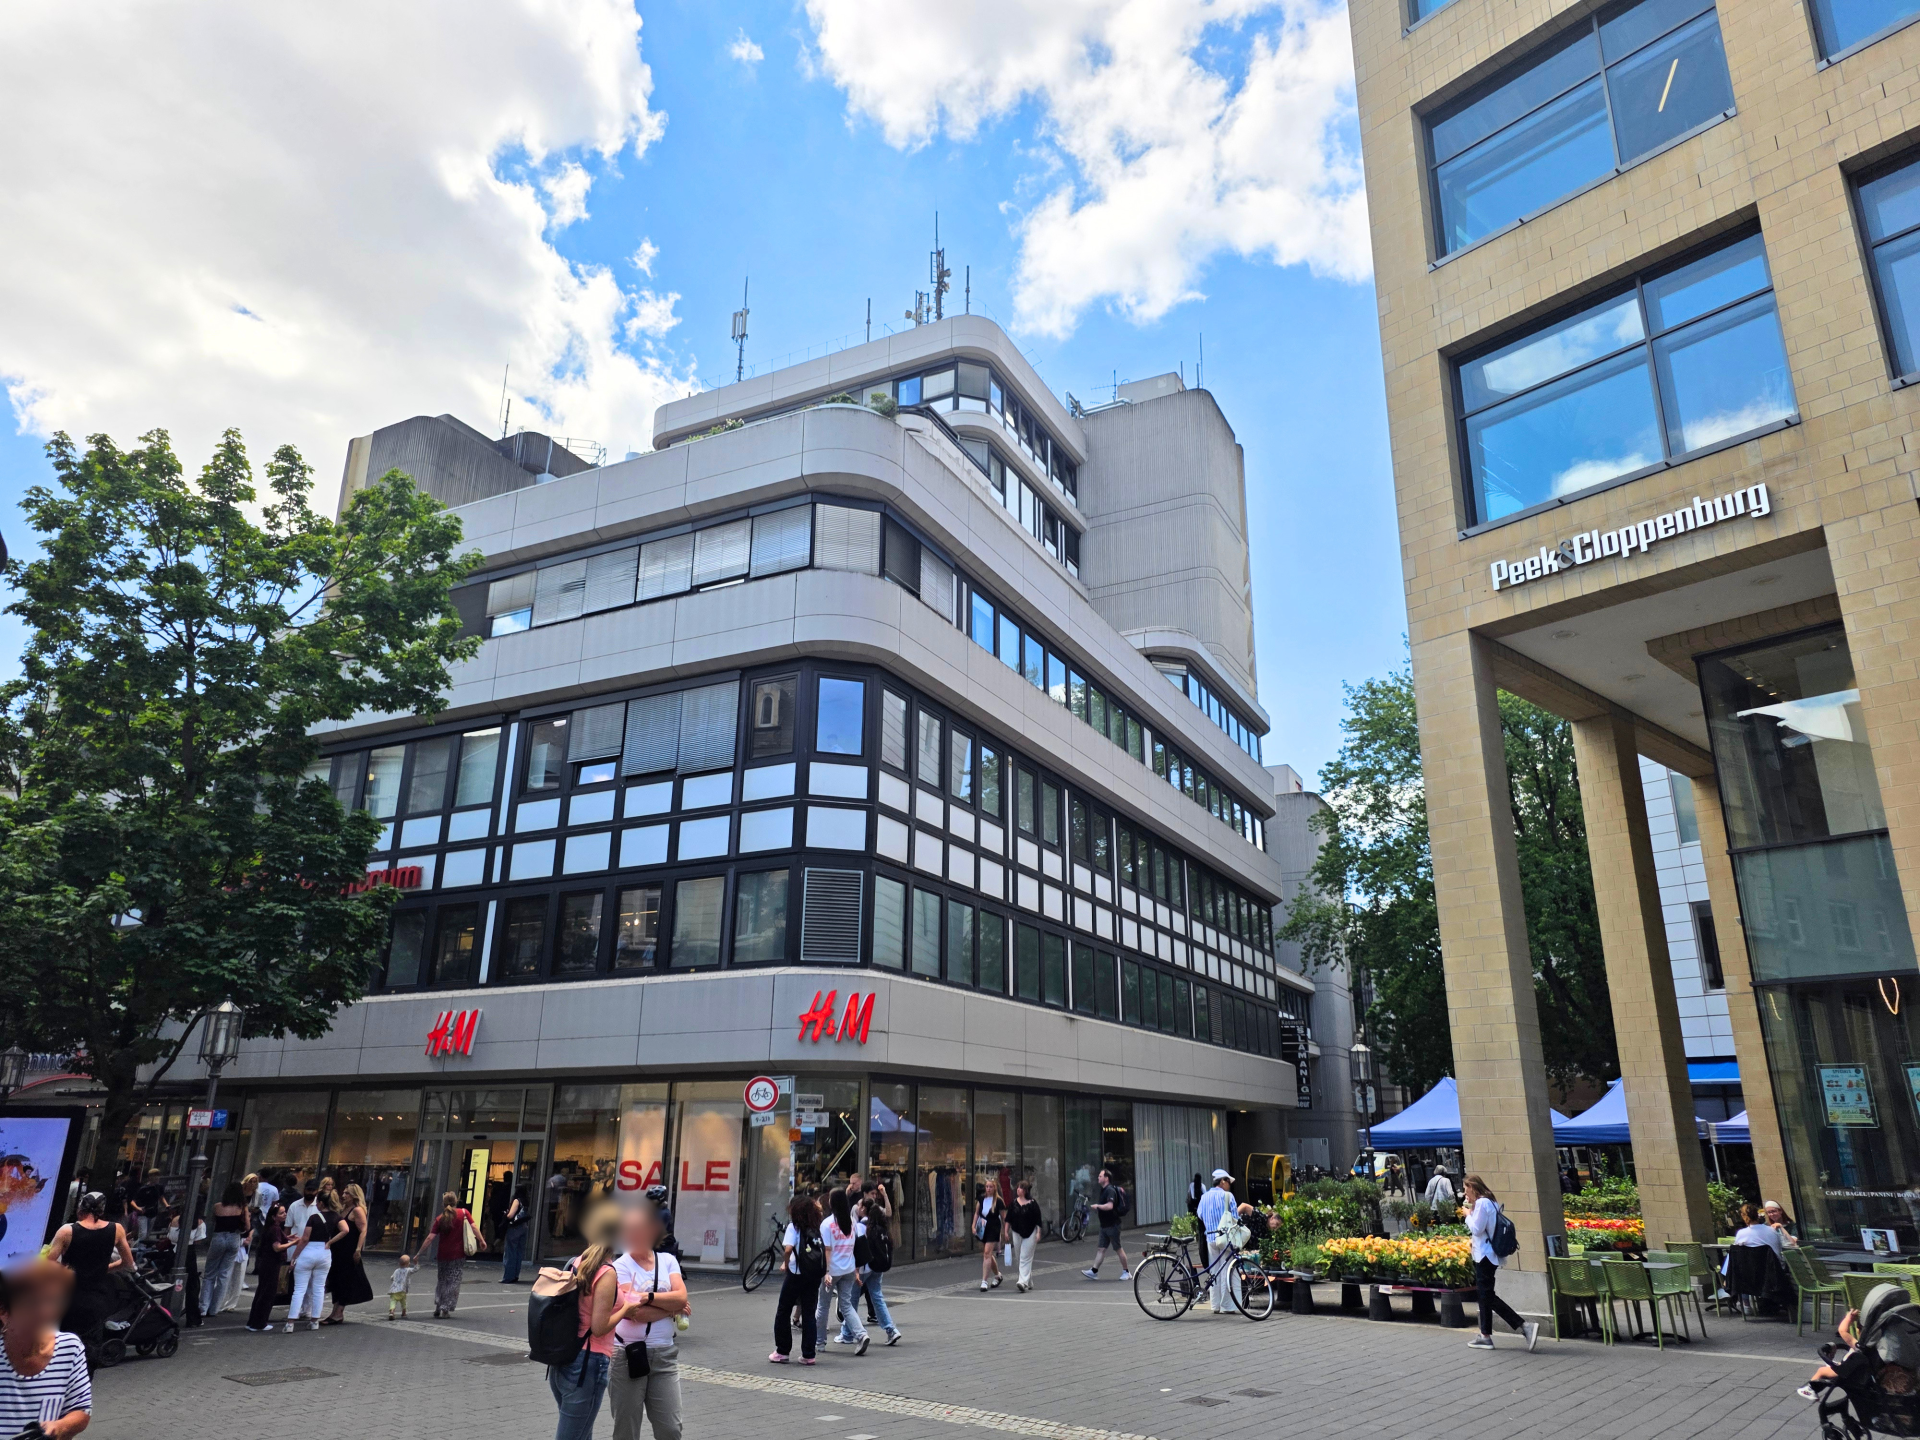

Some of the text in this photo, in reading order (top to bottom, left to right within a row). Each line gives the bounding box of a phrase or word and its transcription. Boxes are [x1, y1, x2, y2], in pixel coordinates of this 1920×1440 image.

[425, 1008, 483, 1057] H&M
[798, 989, 876, 1045] H&M
[1296, 1026, 1310, 1093] SLAMANIG
[616, 1160, 731, 1192] SALE
